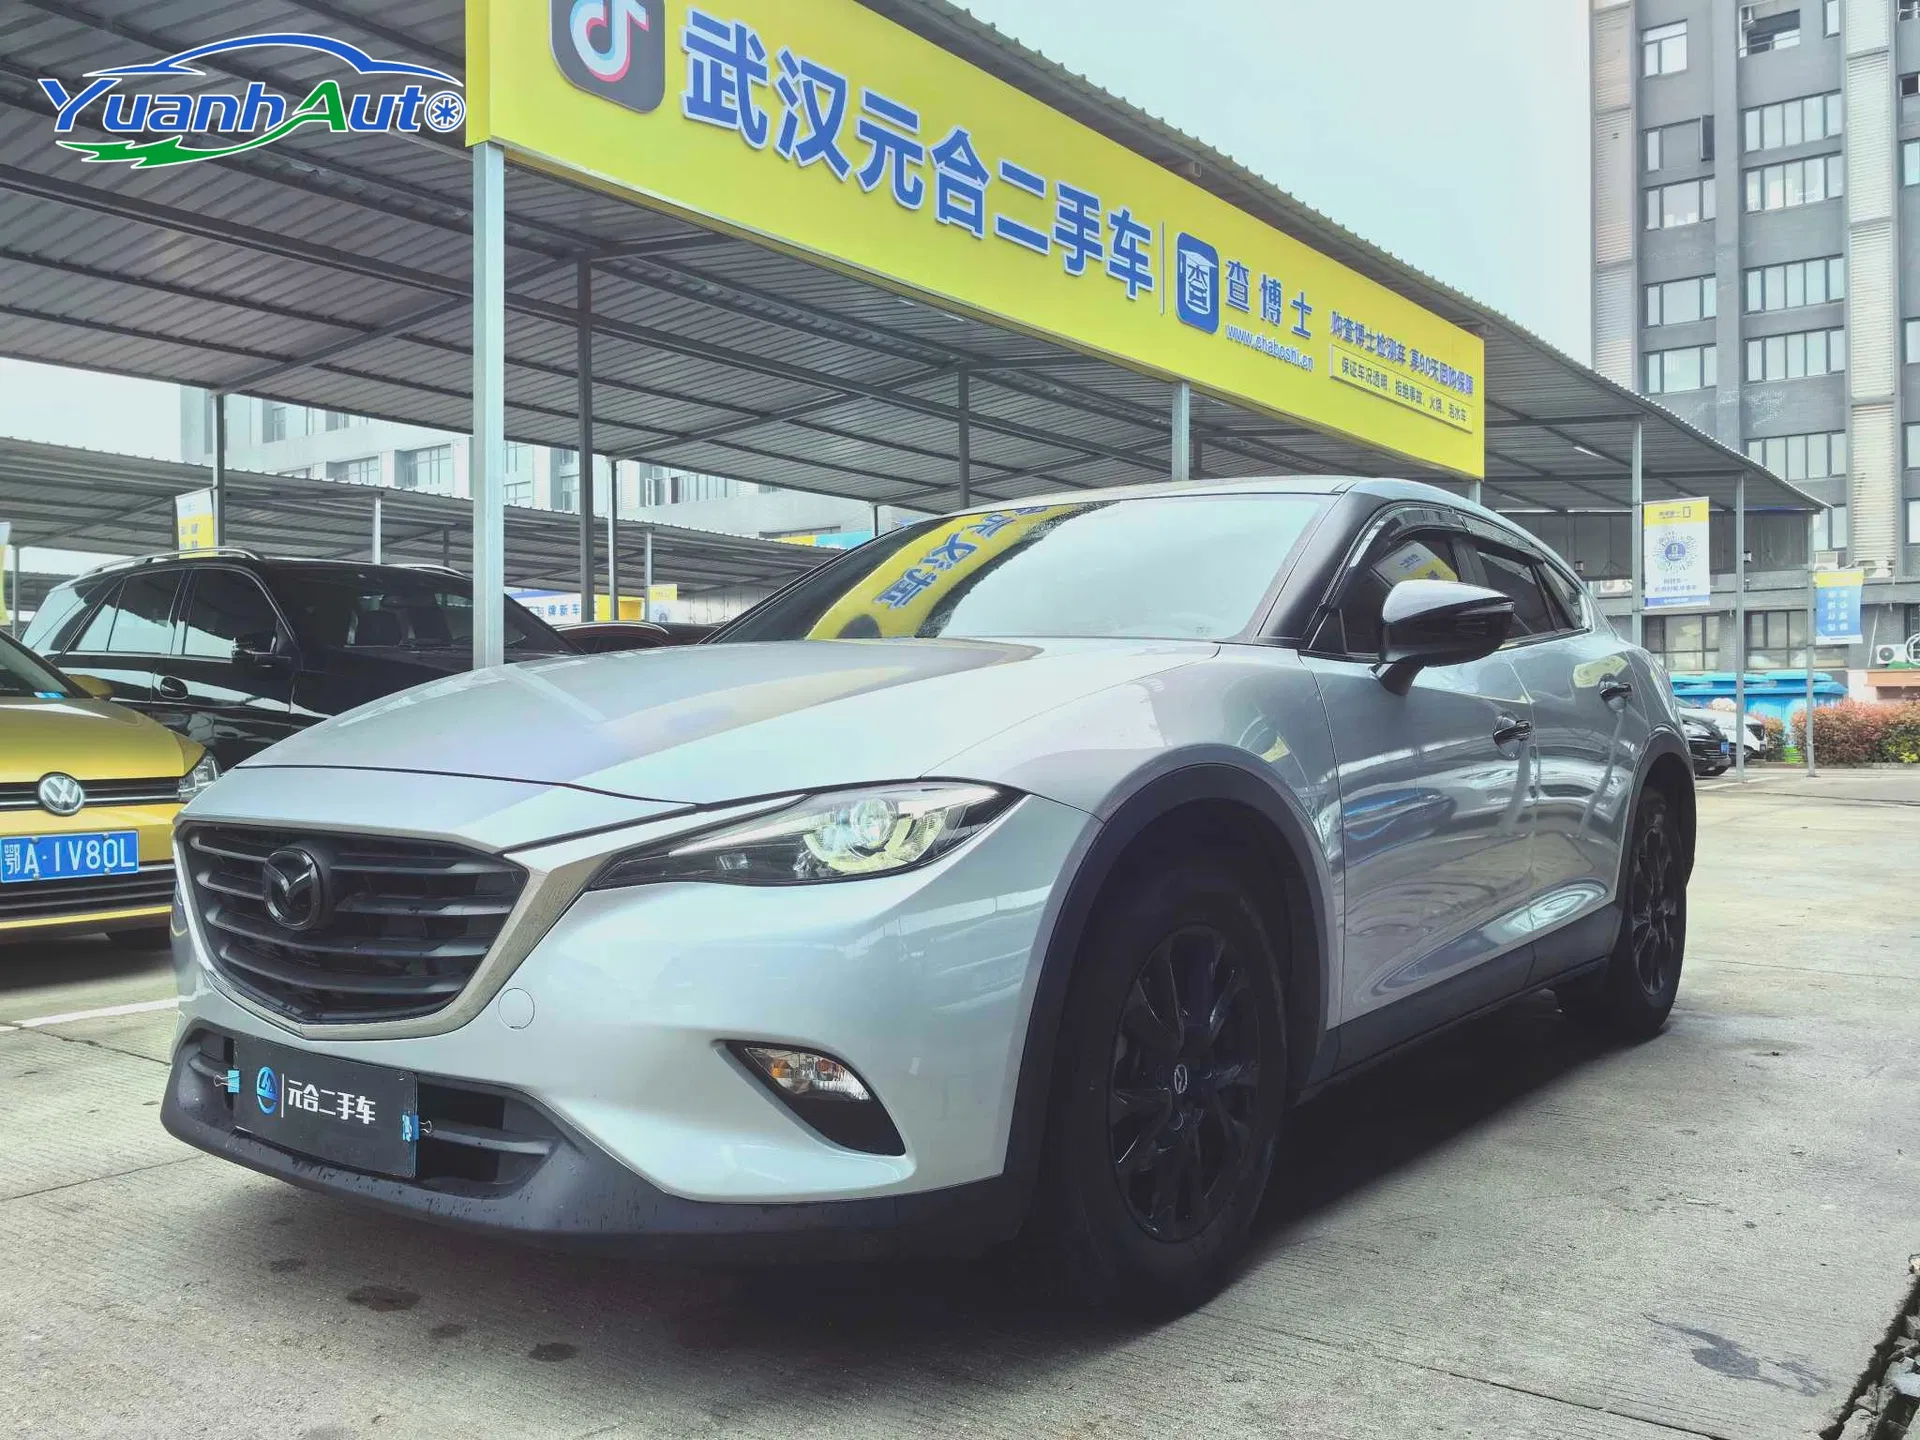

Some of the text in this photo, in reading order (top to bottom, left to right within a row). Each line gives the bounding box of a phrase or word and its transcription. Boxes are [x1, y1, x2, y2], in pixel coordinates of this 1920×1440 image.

[681, 8, 1154, 301] 武汉元合二手车
[1225, 258, 1313, 341] 查博士
[287, 1079, 376, 1125] 元合二手车
